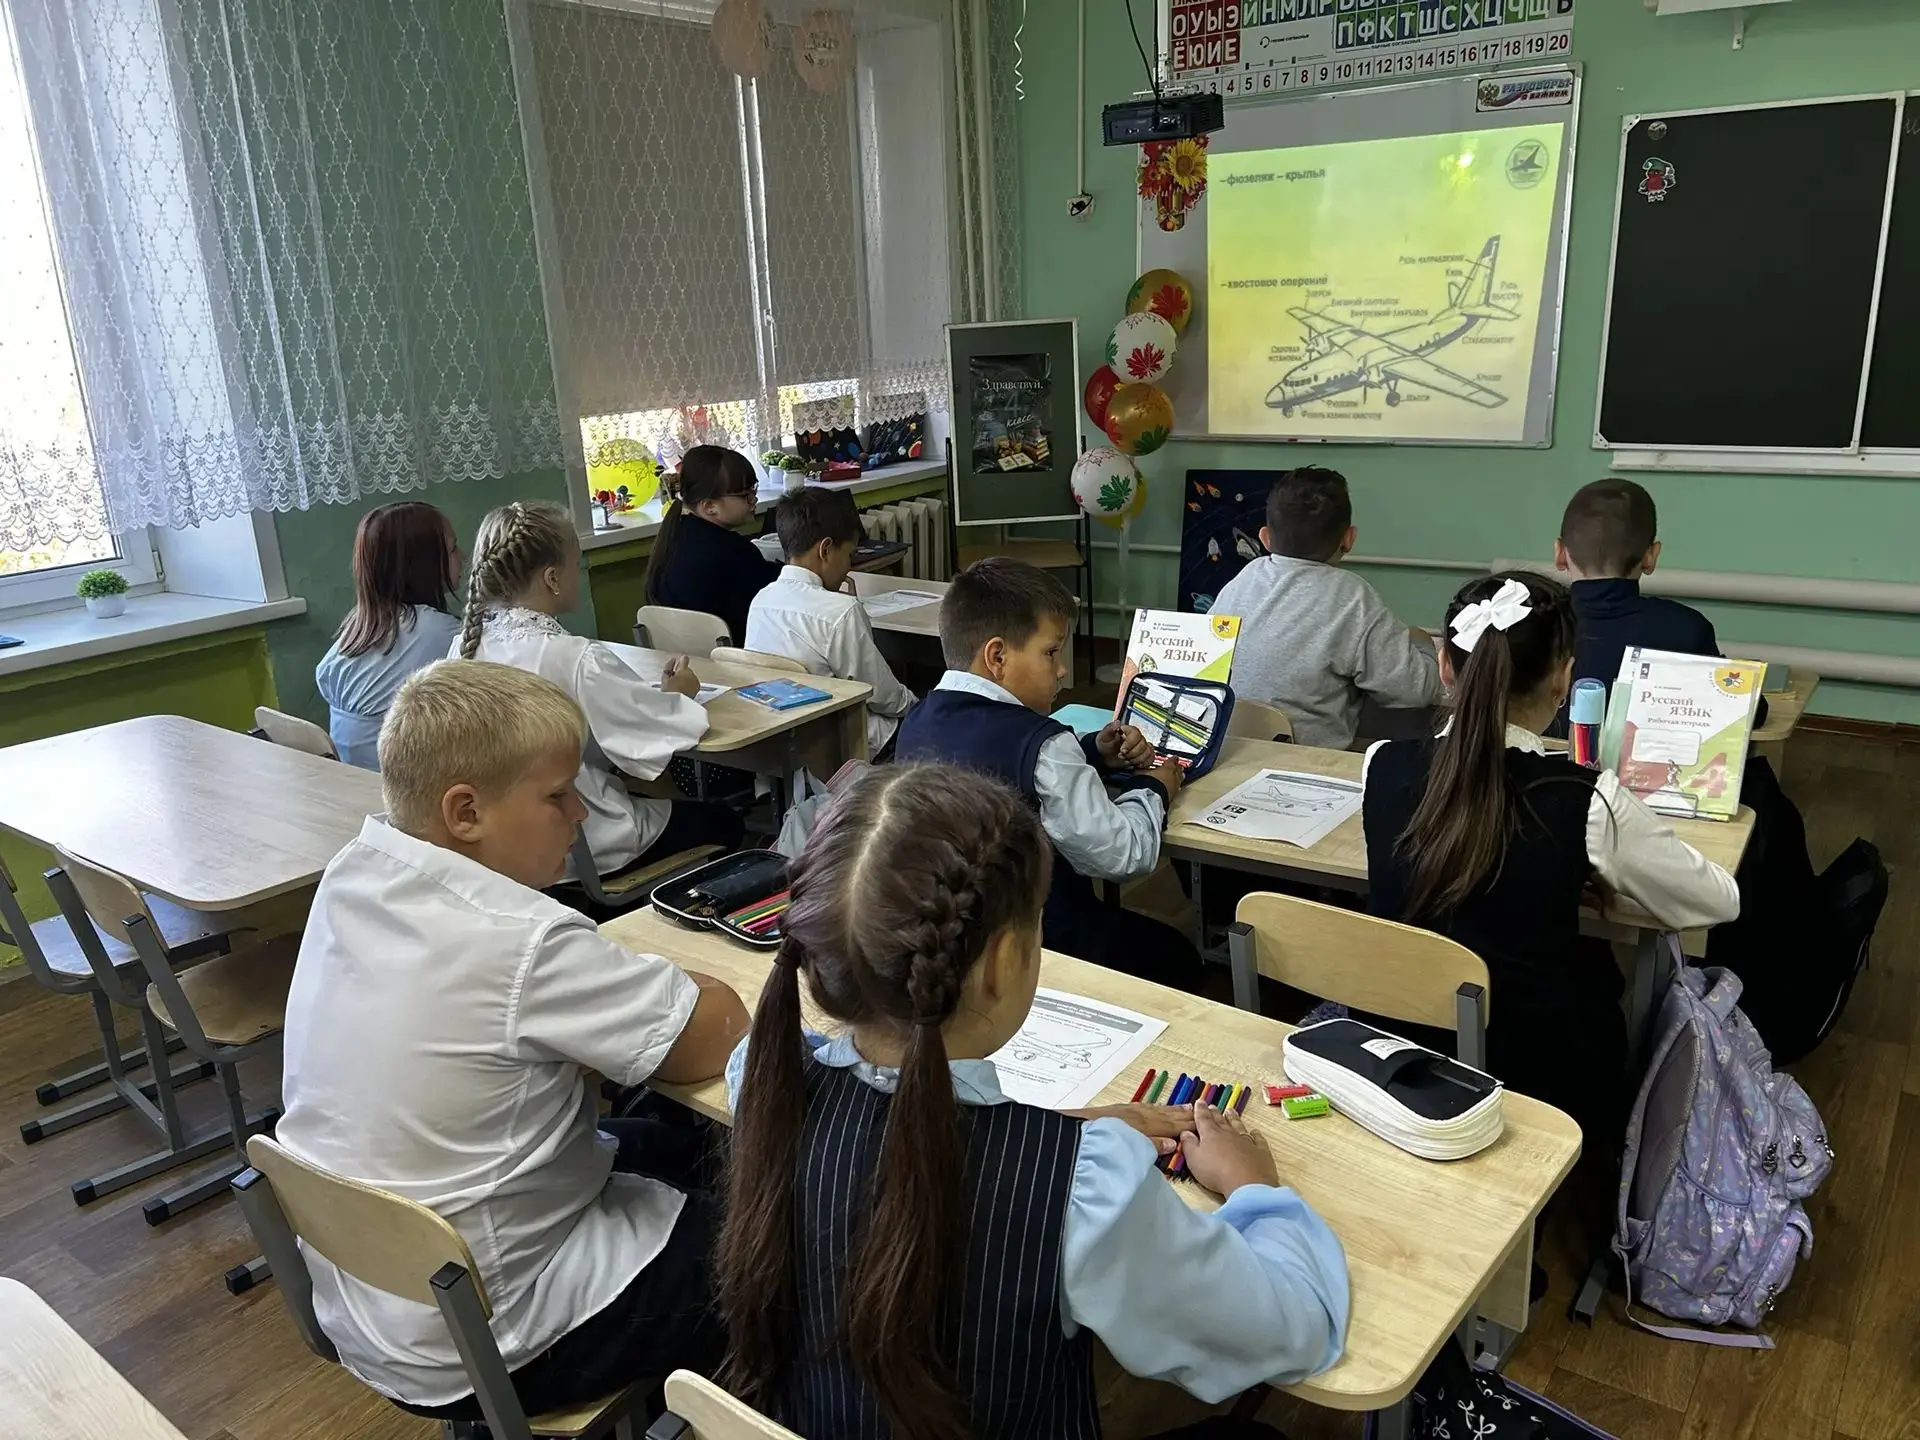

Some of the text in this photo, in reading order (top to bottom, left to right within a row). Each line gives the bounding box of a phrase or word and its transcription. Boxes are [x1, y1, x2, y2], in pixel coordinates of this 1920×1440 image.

[1210, 34, 1568, 94] 3 4 5 6 7 8 9 10 11 12 13 14 15 16 17 18 19 20
[1138, 629, 1195, 648] Русский
[1640, 690, 1694, 706] Русский
